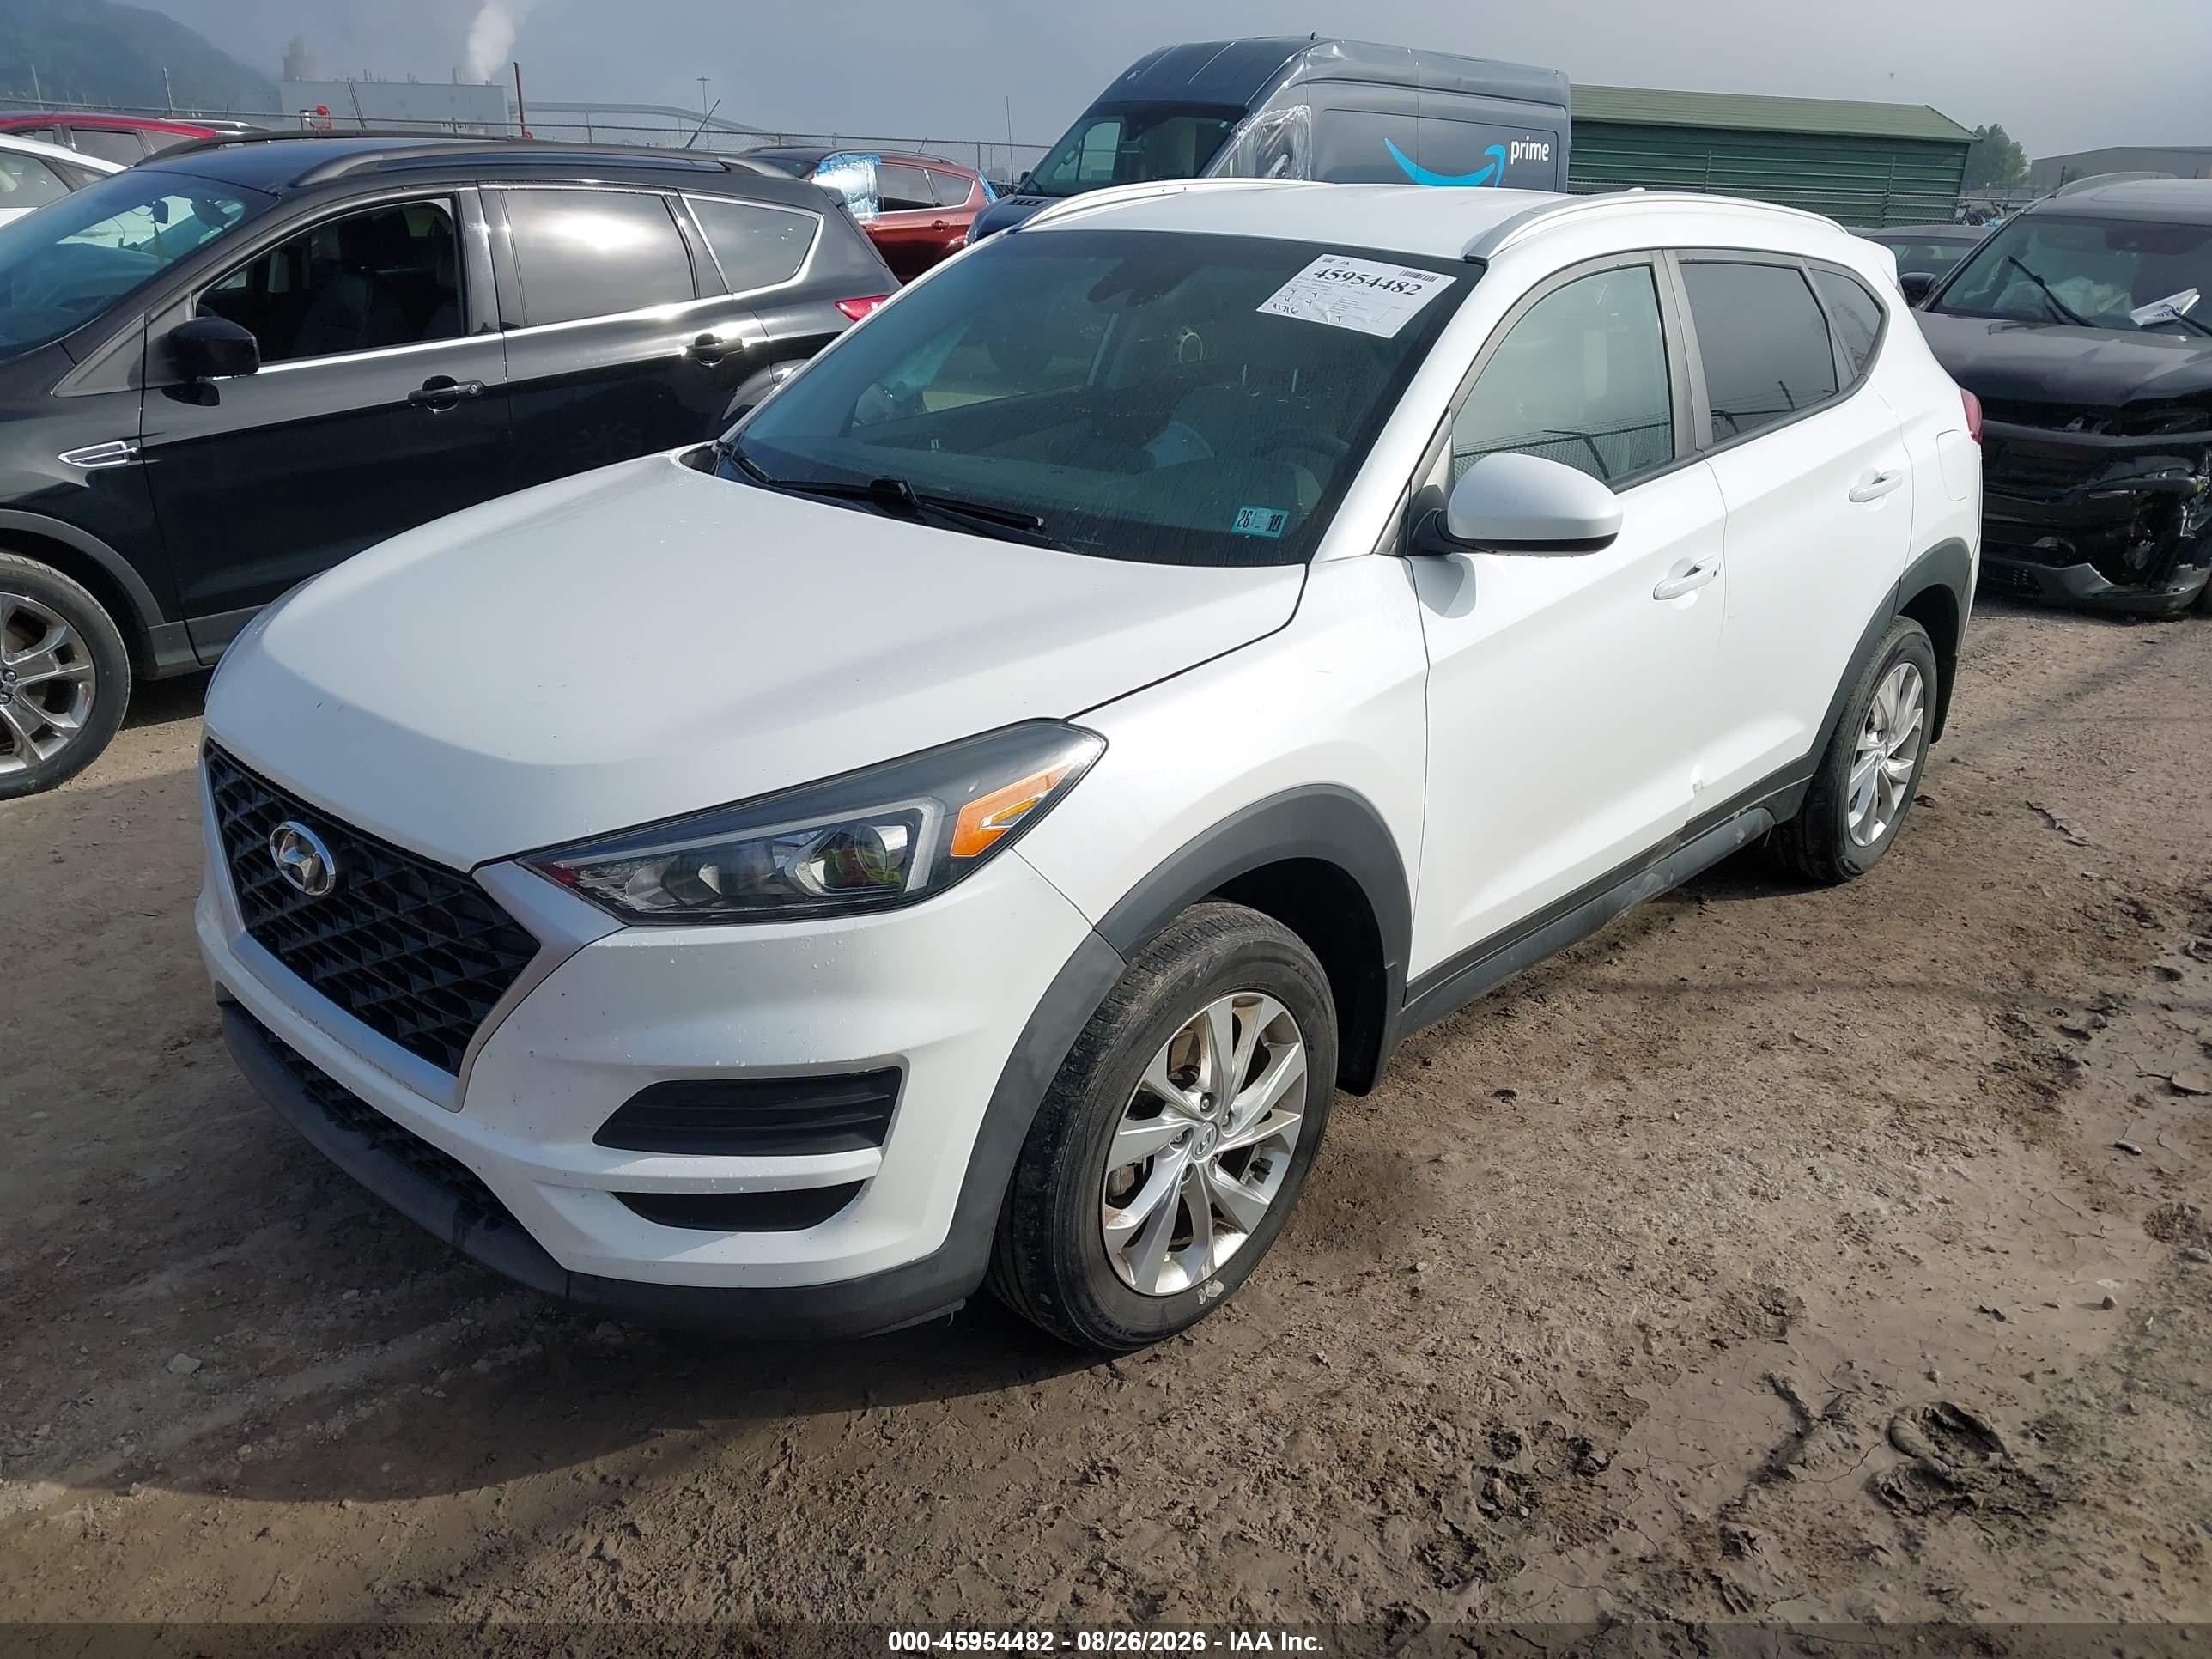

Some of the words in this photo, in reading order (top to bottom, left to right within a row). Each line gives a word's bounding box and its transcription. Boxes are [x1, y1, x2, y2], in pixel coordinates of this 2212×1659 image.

[1510, 135, 1549, 165] prime
[1313, 268, 1423, 296] 45954482
[1237, 509, 1254, 529] 26
